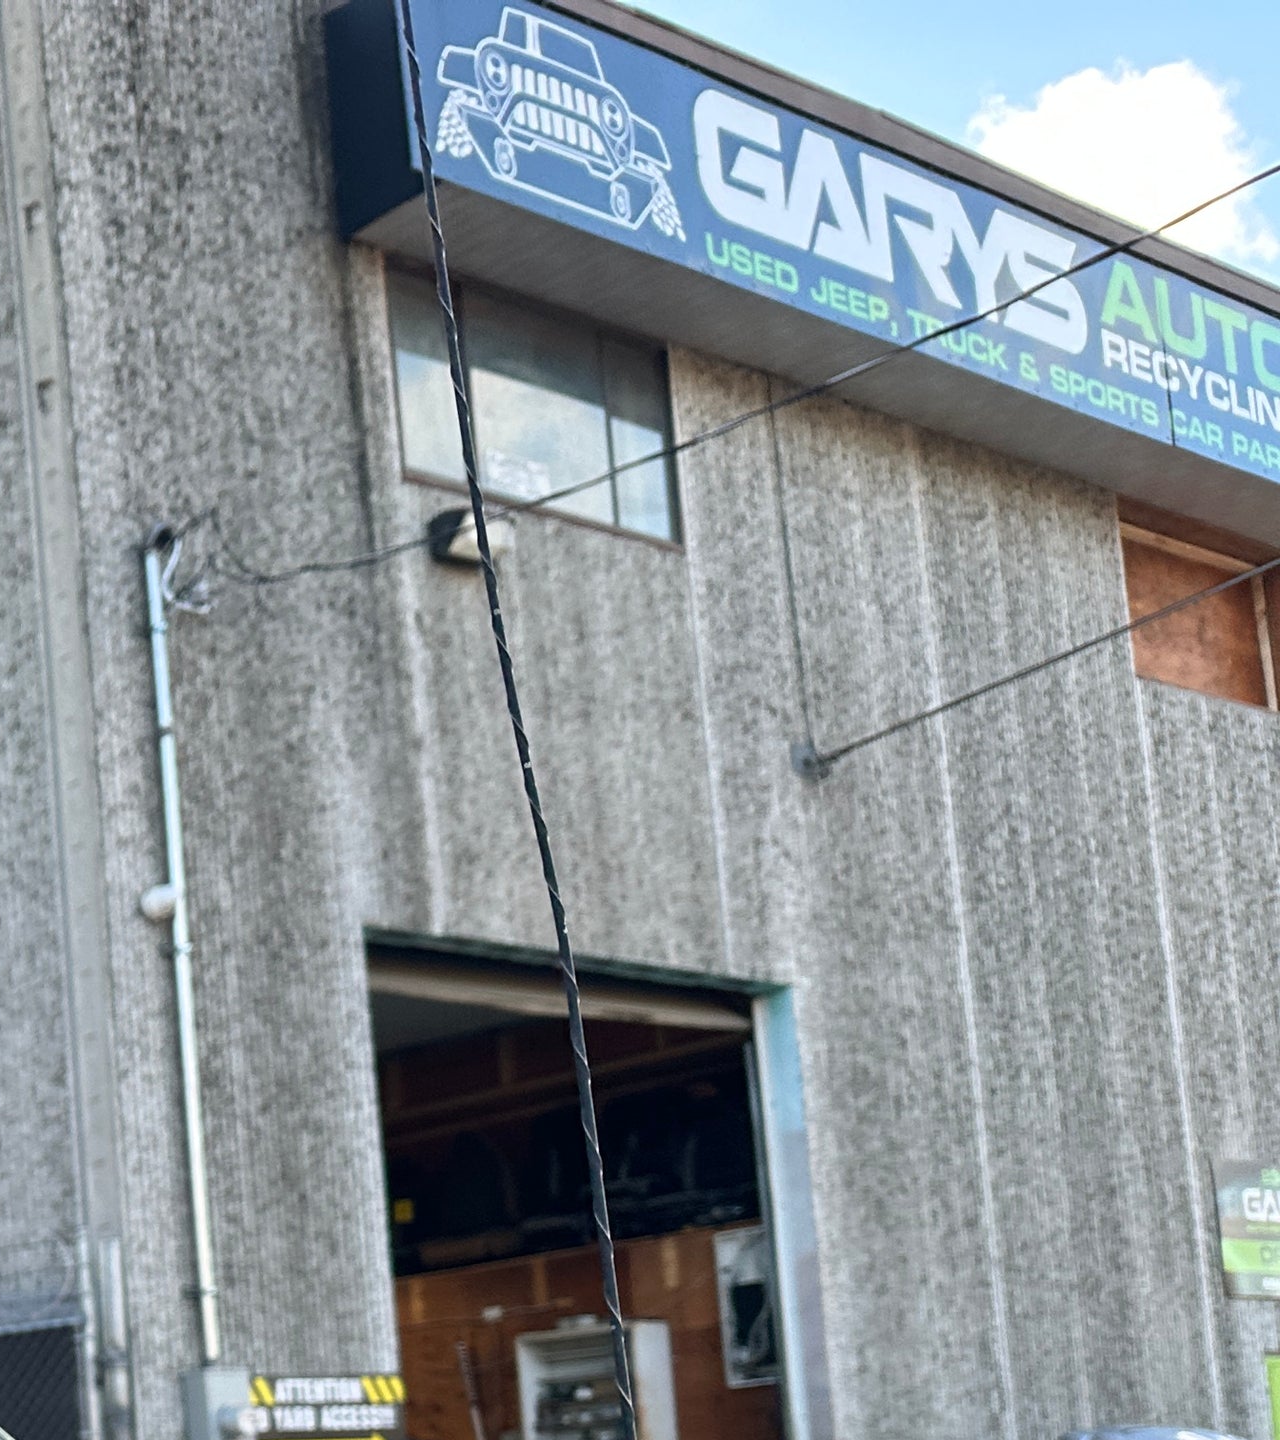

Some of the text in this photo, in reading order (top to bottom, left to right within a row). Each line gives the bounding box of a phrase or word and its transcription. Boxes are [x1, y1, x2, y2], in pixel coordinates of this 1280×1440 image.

[693, 88, 1088, 355] GARYS
[705, 232, 799, 294] USED
[810, 277, 898, 337] JEEP,
[906, 308, 1009, 371] TRUCK
[1019, 351, 1040, 383] &
[1049, 364, 1161, 428] SPORTS
[1171, 407, 1224, 450] CAR
[1241, 1187, 1280, 1223] GA
